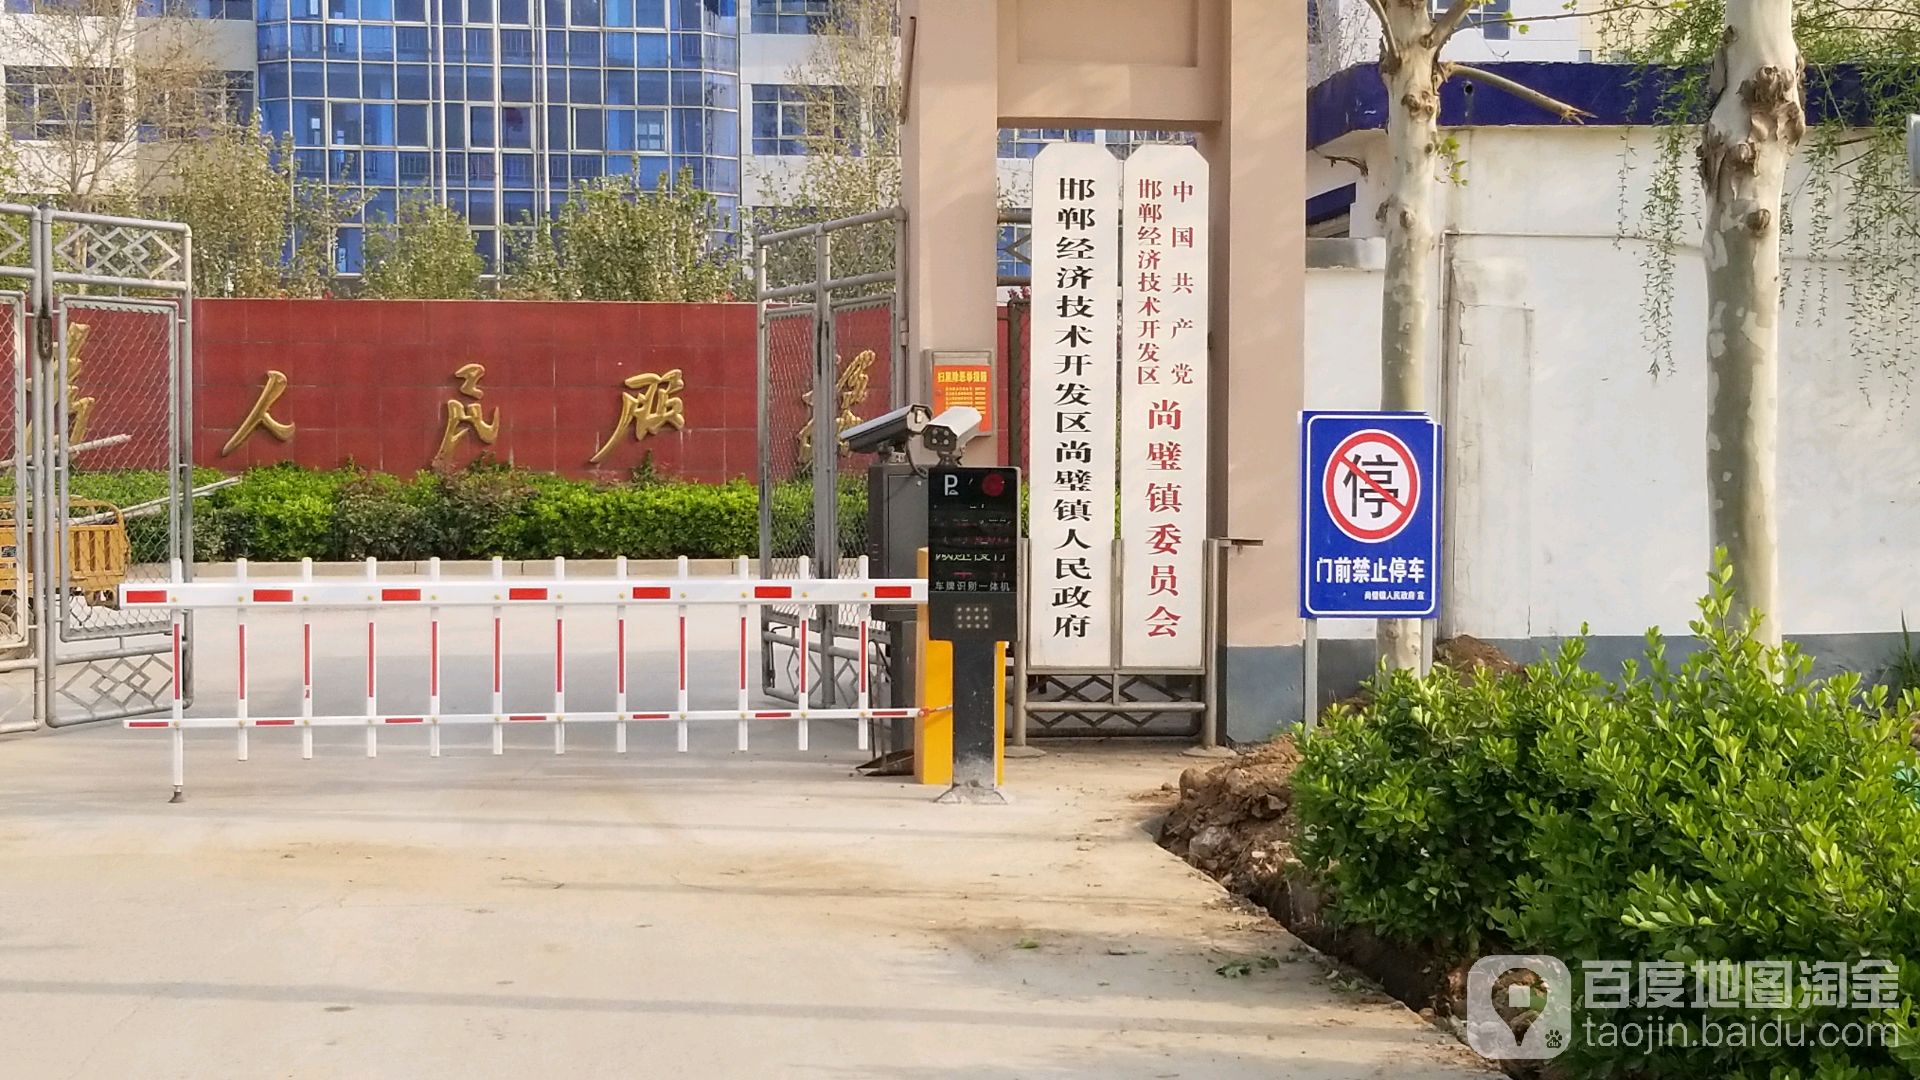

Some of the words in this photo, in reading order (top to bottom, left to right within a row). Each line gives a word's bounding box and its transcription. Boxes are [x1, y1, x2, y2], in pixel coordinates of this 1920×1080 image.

[1137, 178, 1163, 386] 邯郸经济技术开发区
[1170, 181, 1194, 385] 中国共产党
[1052, 177, 1096, 638] 邯郸经济技术开发区尚璧镇人民政府
[1343, 454, 1399, 519] 停
[935, 581, 1011, 592] 车牌识别一体机
[1145, 399, 1183, 638] 尚璧镇委员会
[1316, 556, 1426, 584] 门前禁止停车
